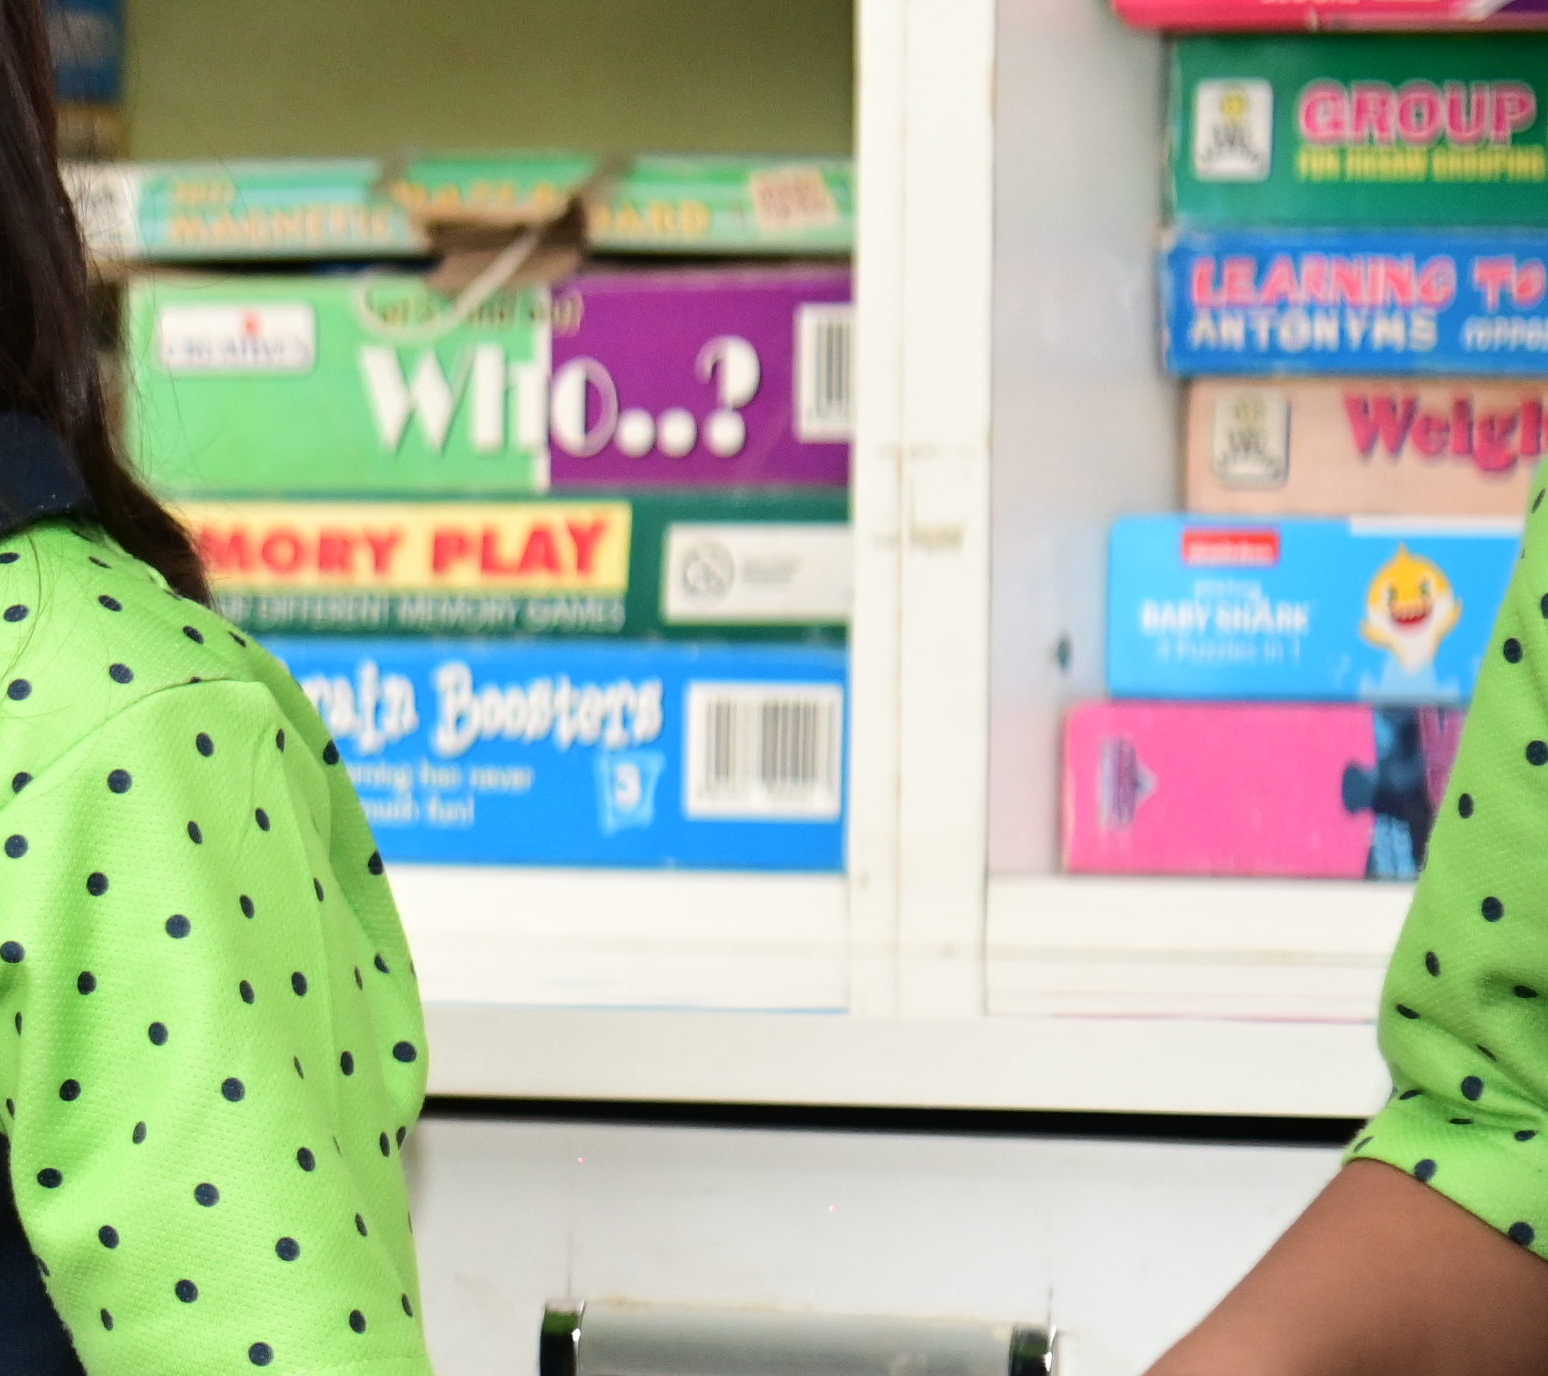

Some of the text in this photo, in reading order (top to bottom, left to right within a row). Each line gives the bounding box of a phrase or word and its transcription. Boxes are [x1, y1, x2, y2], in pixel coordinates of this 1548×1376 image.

[1297, 79, 1538, 147] GROUP
[1191, 253, 1457, 311] LEARNING
[1193, 307, 1438, 352] ANTONYMS
[199, 513, 612, 576] MORY PLAY
[299, 658, 663, 760] rain Boosters
